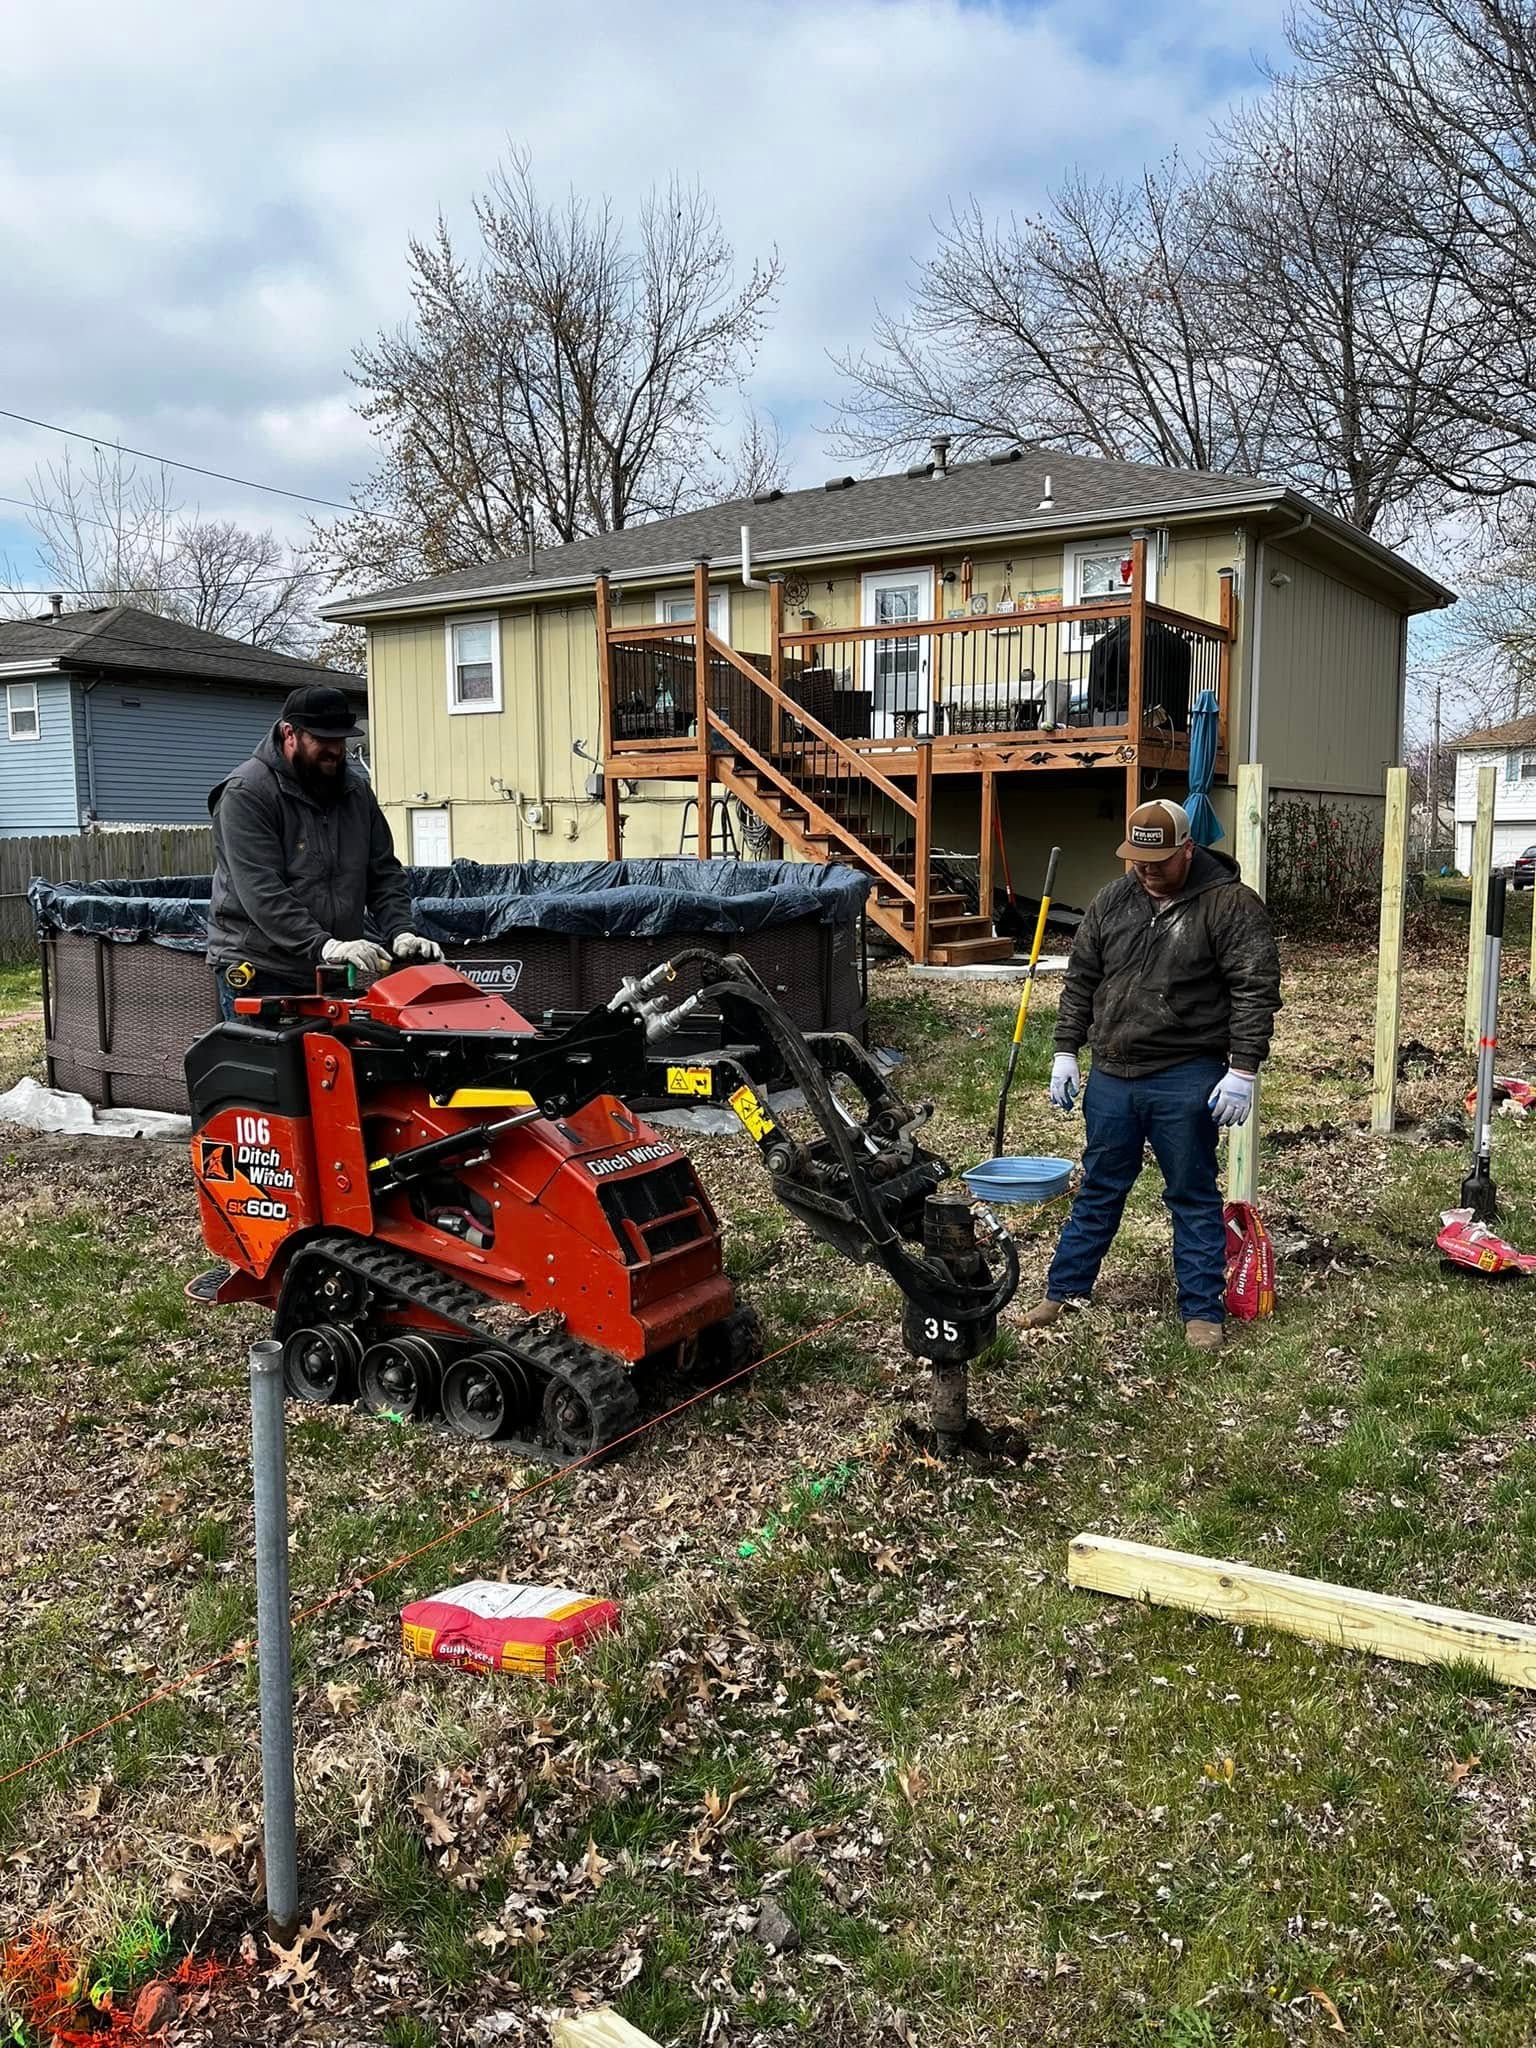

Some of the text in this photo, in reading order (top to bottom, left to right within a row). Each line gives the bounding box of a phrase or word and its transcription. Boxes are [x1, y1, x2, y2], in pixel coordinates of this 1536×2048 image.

[236, 1116, 270, 1145] 106
[238, 1146, 280, 1167] Ditch
[586, 1141, 674, 1175] Ditch Witch
[250, 1166, 294, 1188] Witch
[228, 1200, 287, 1219] SK600
[924, 1317, 958, 1342] 35
